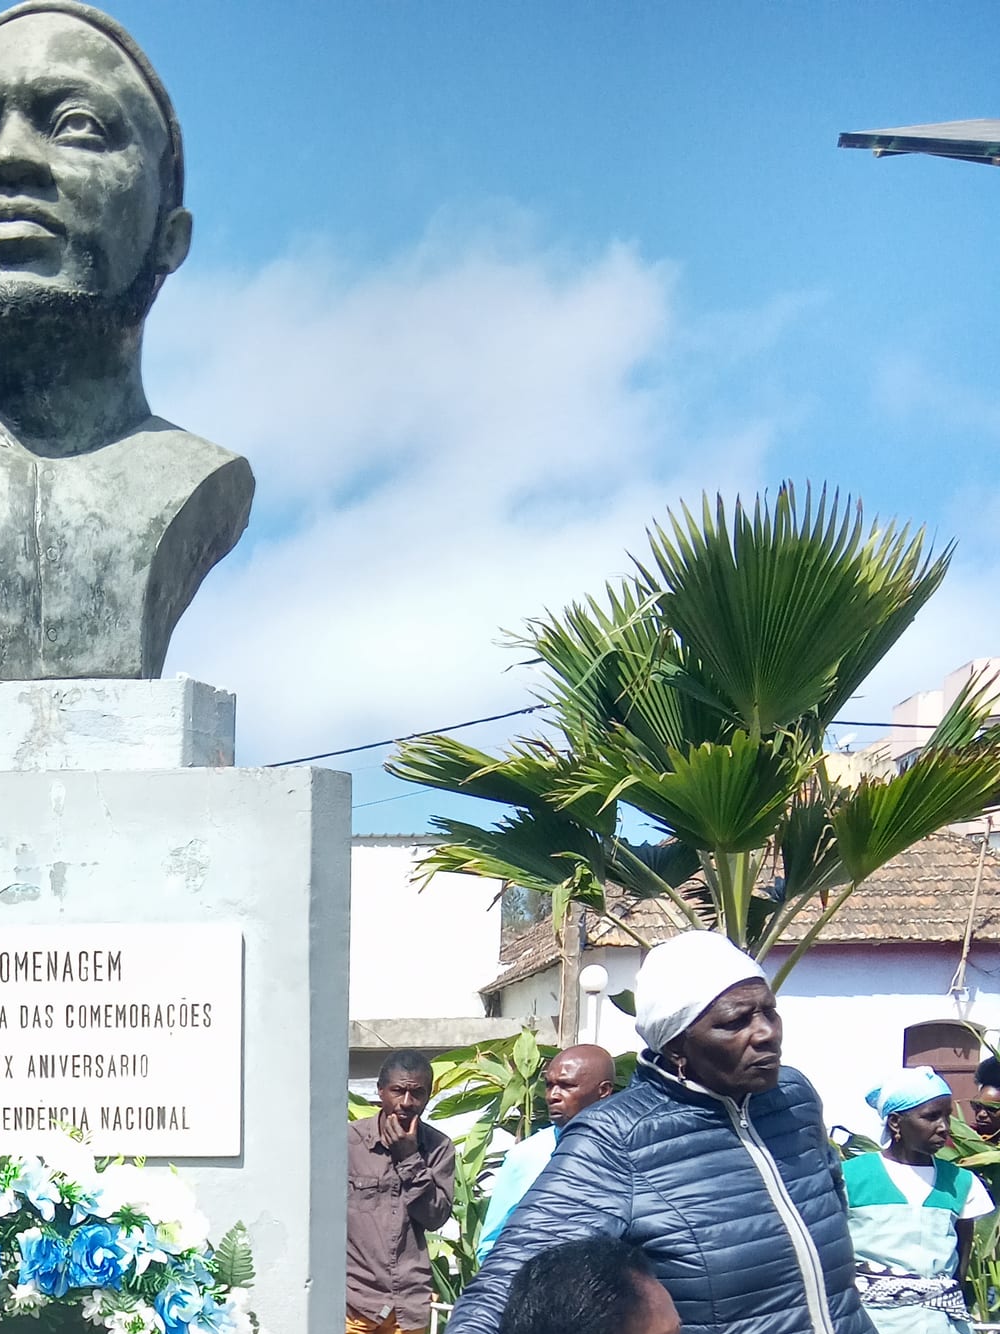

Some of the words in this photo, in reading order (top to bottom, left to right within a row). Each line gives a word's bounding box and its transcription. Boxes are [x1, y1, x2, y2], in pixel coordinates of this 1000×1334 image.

[19, 1004, 54, 1029] DAS
[27, 1054, 149, 1079] ANIVERSARIO
[100, 1106, 190, 1131] NACIONAL
